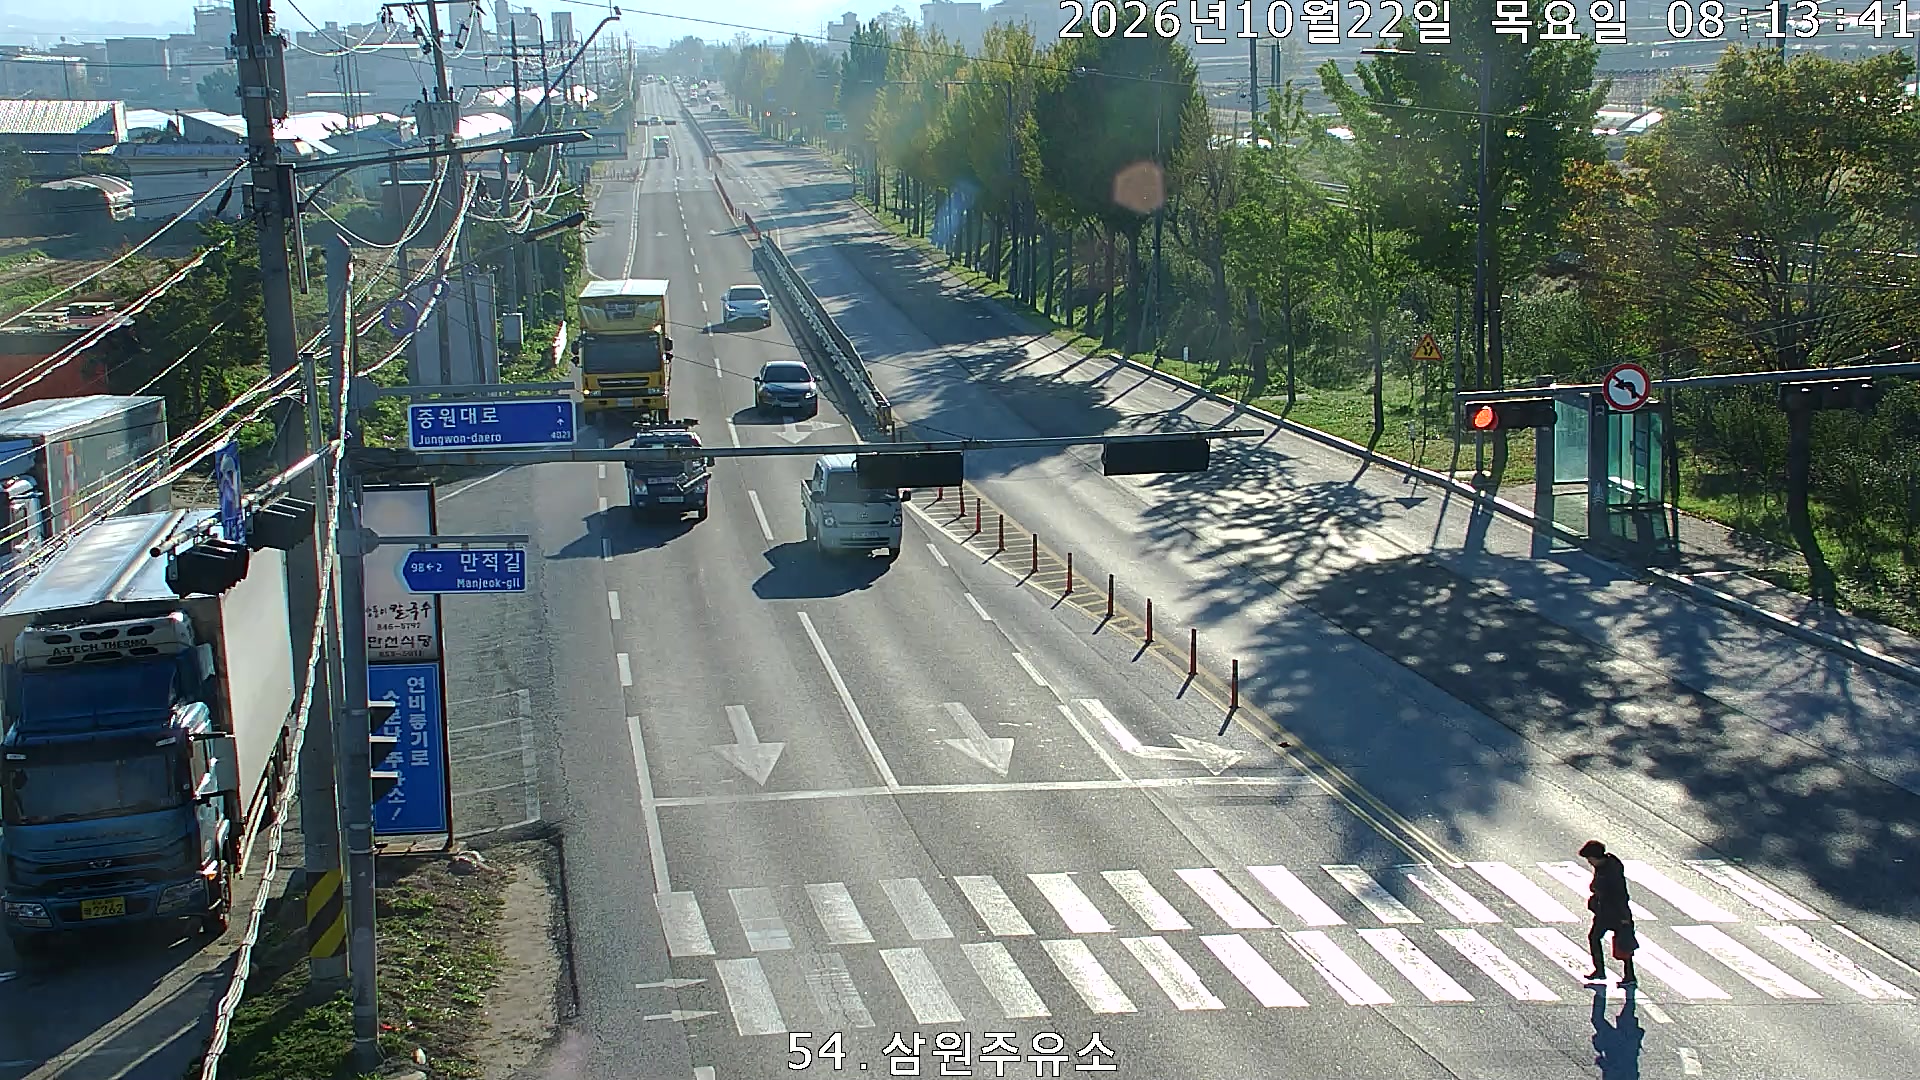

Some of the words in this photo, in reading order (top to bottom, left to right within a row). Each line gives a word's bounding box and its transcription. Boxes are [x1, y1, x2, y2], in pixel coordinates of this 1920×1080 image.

[416, 407, 500, 429] 중원대로
[418, 432, 502, 447] Jungwon-daero
[460, 552, 521, 573] 만적길
[456, 578, 521, 590] Manjeok-gil
[389, 601, 433, 621] 칼국수
[52, 643, 99, 657] A-TECH
[100, 638, 149, 651] THERMO
